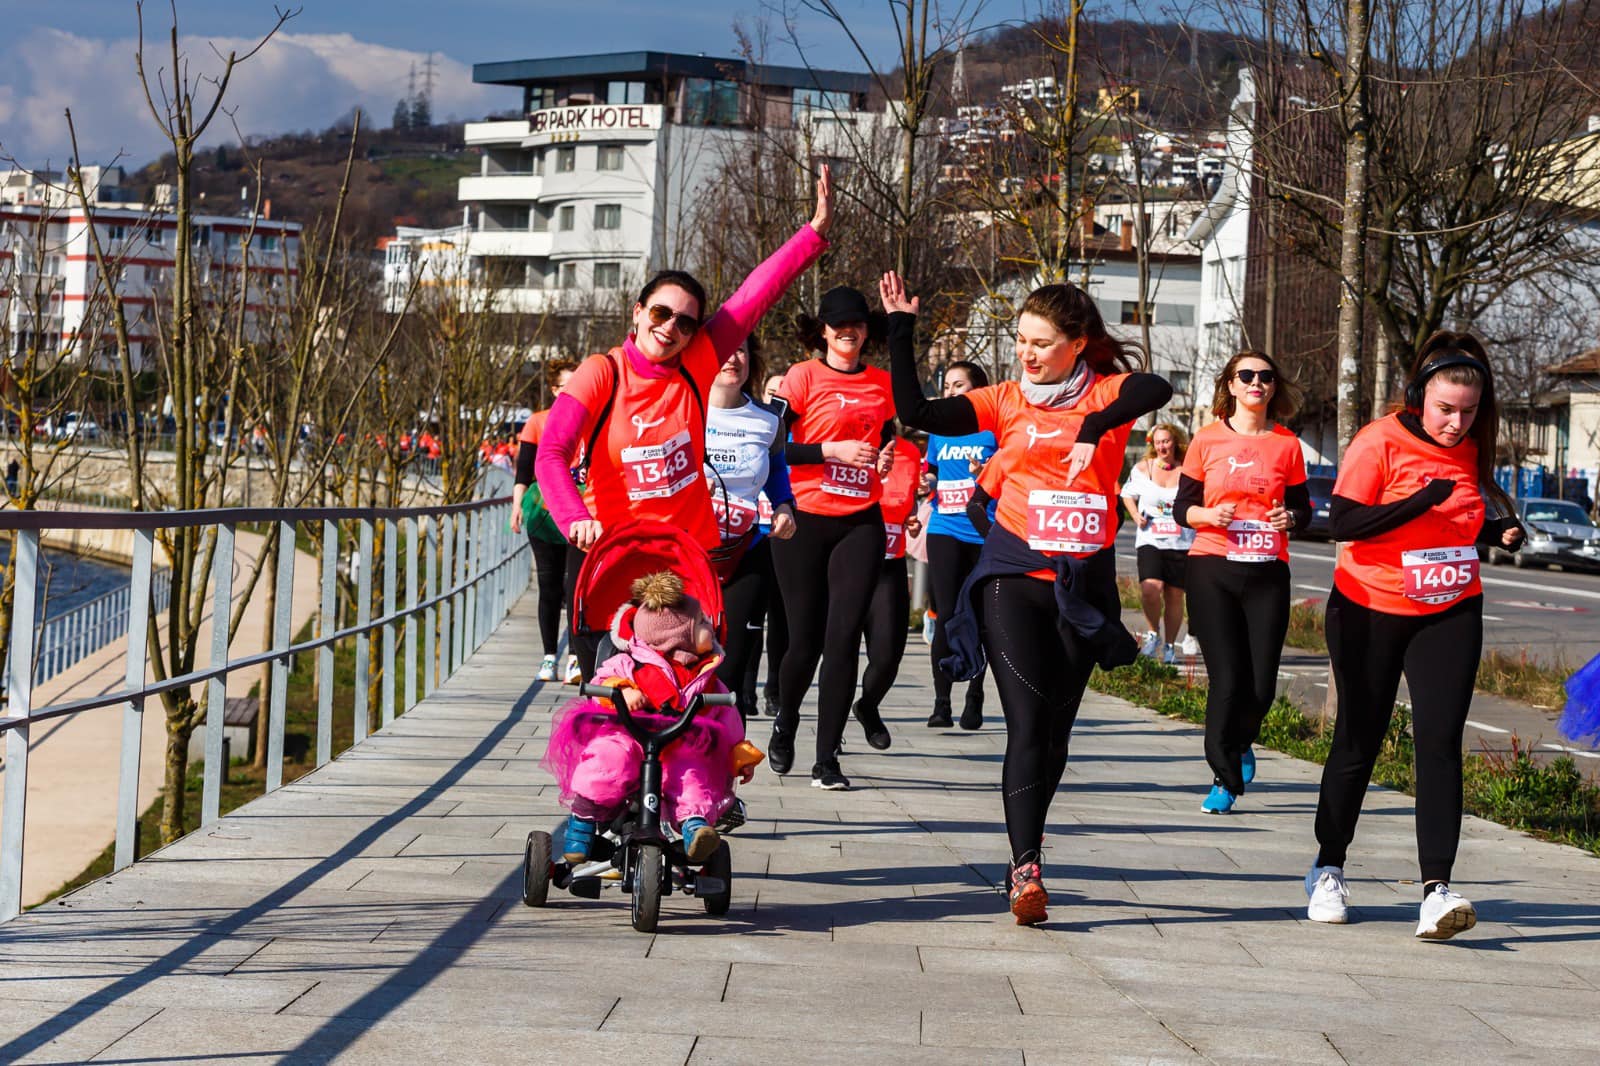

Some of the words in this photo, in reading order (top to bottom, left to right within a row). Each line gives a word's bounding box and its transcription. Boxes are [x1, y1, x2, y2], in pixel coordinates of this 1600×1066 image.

[549, 108, 587, 129] PARK
[591, 107, 650, 128] HOTEL
[708, 453, 736, 462] reen
[937, 443, 984, 461] ARRK
[631, 450, 688, 484] 1348
[830, 465, 869, 485] 1338
[942, 490, 969, 504] 1321
[1035, 509, 1100, 535] 1408
[1236, 533, 1274, 549] 1195
[1411, 564, 1472, 590] 1405
